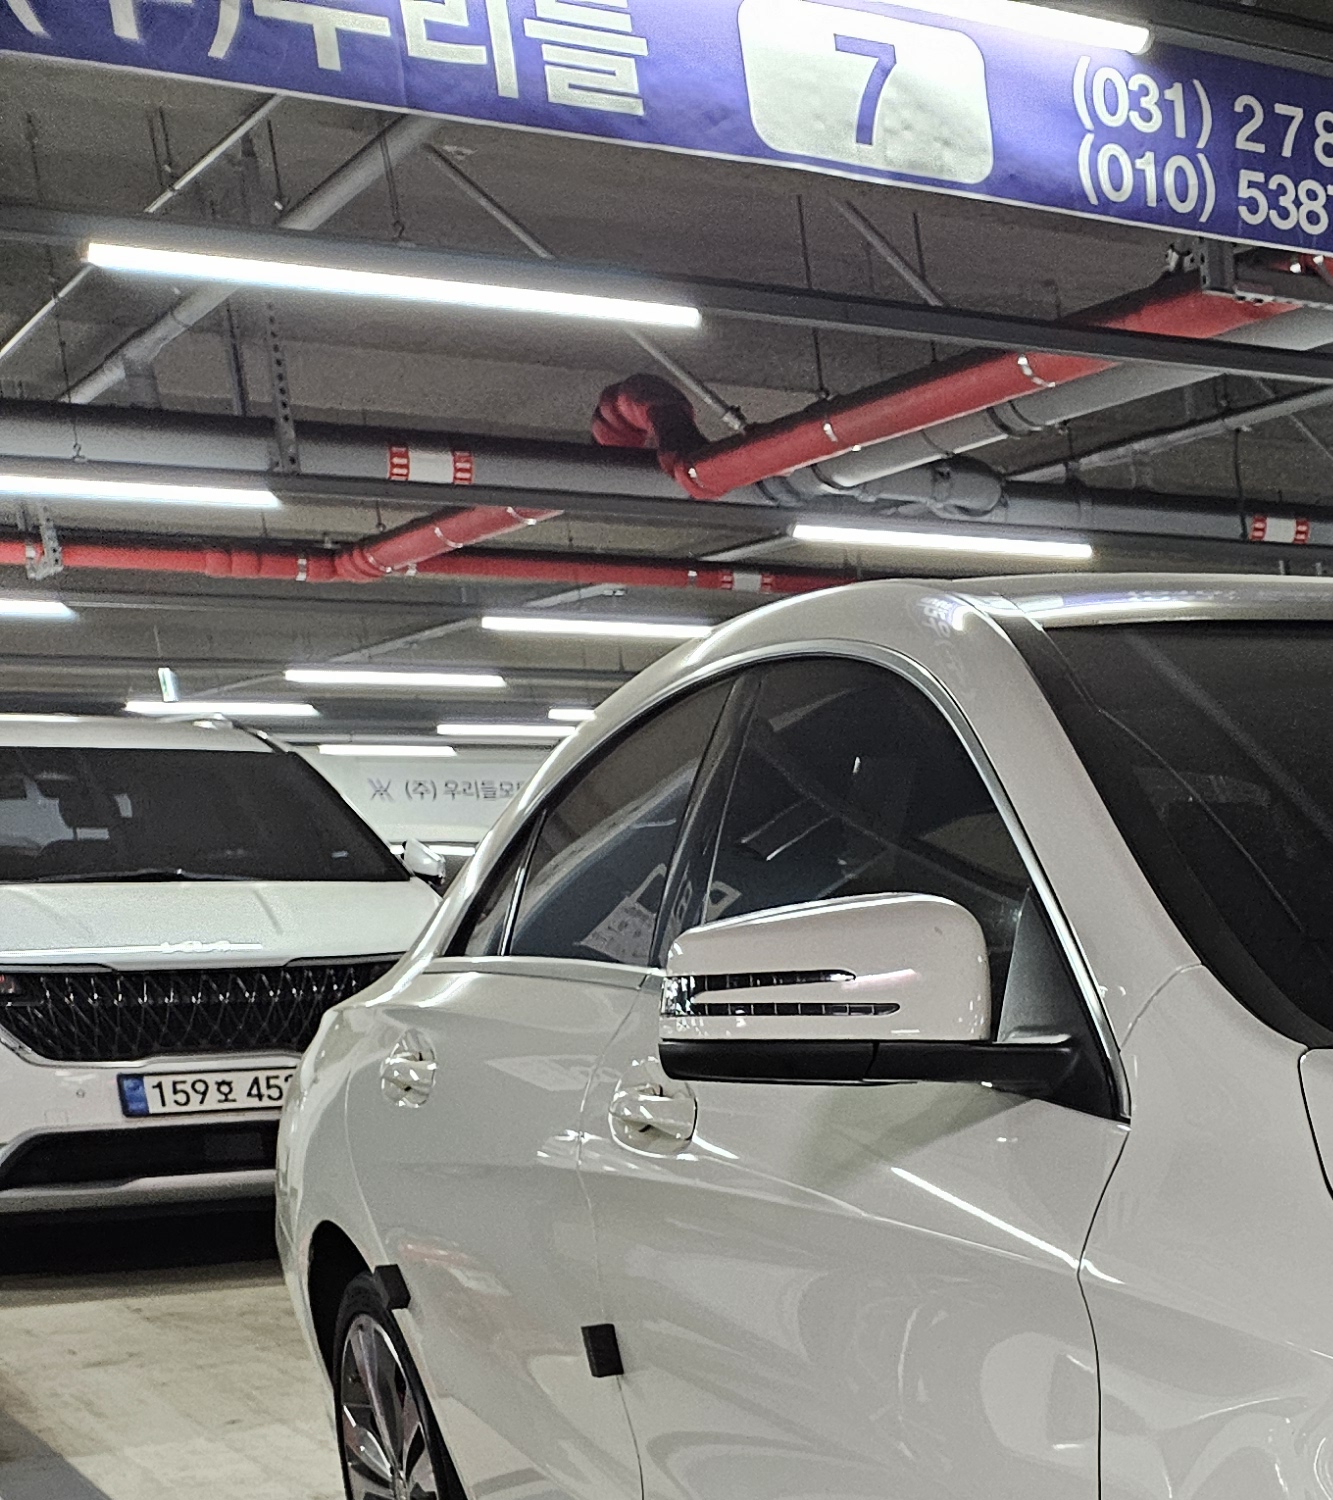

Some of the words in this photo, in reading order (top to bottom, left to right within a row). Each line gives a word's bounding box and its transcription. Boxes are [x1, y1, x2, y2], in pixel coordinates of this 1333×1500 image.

[834, 33, 897, 147] 7
[1073, 55, 1213, 149] (031)
[1078, 133, 1216, 223] (010)
[405, 780, 437, 801] (주)
